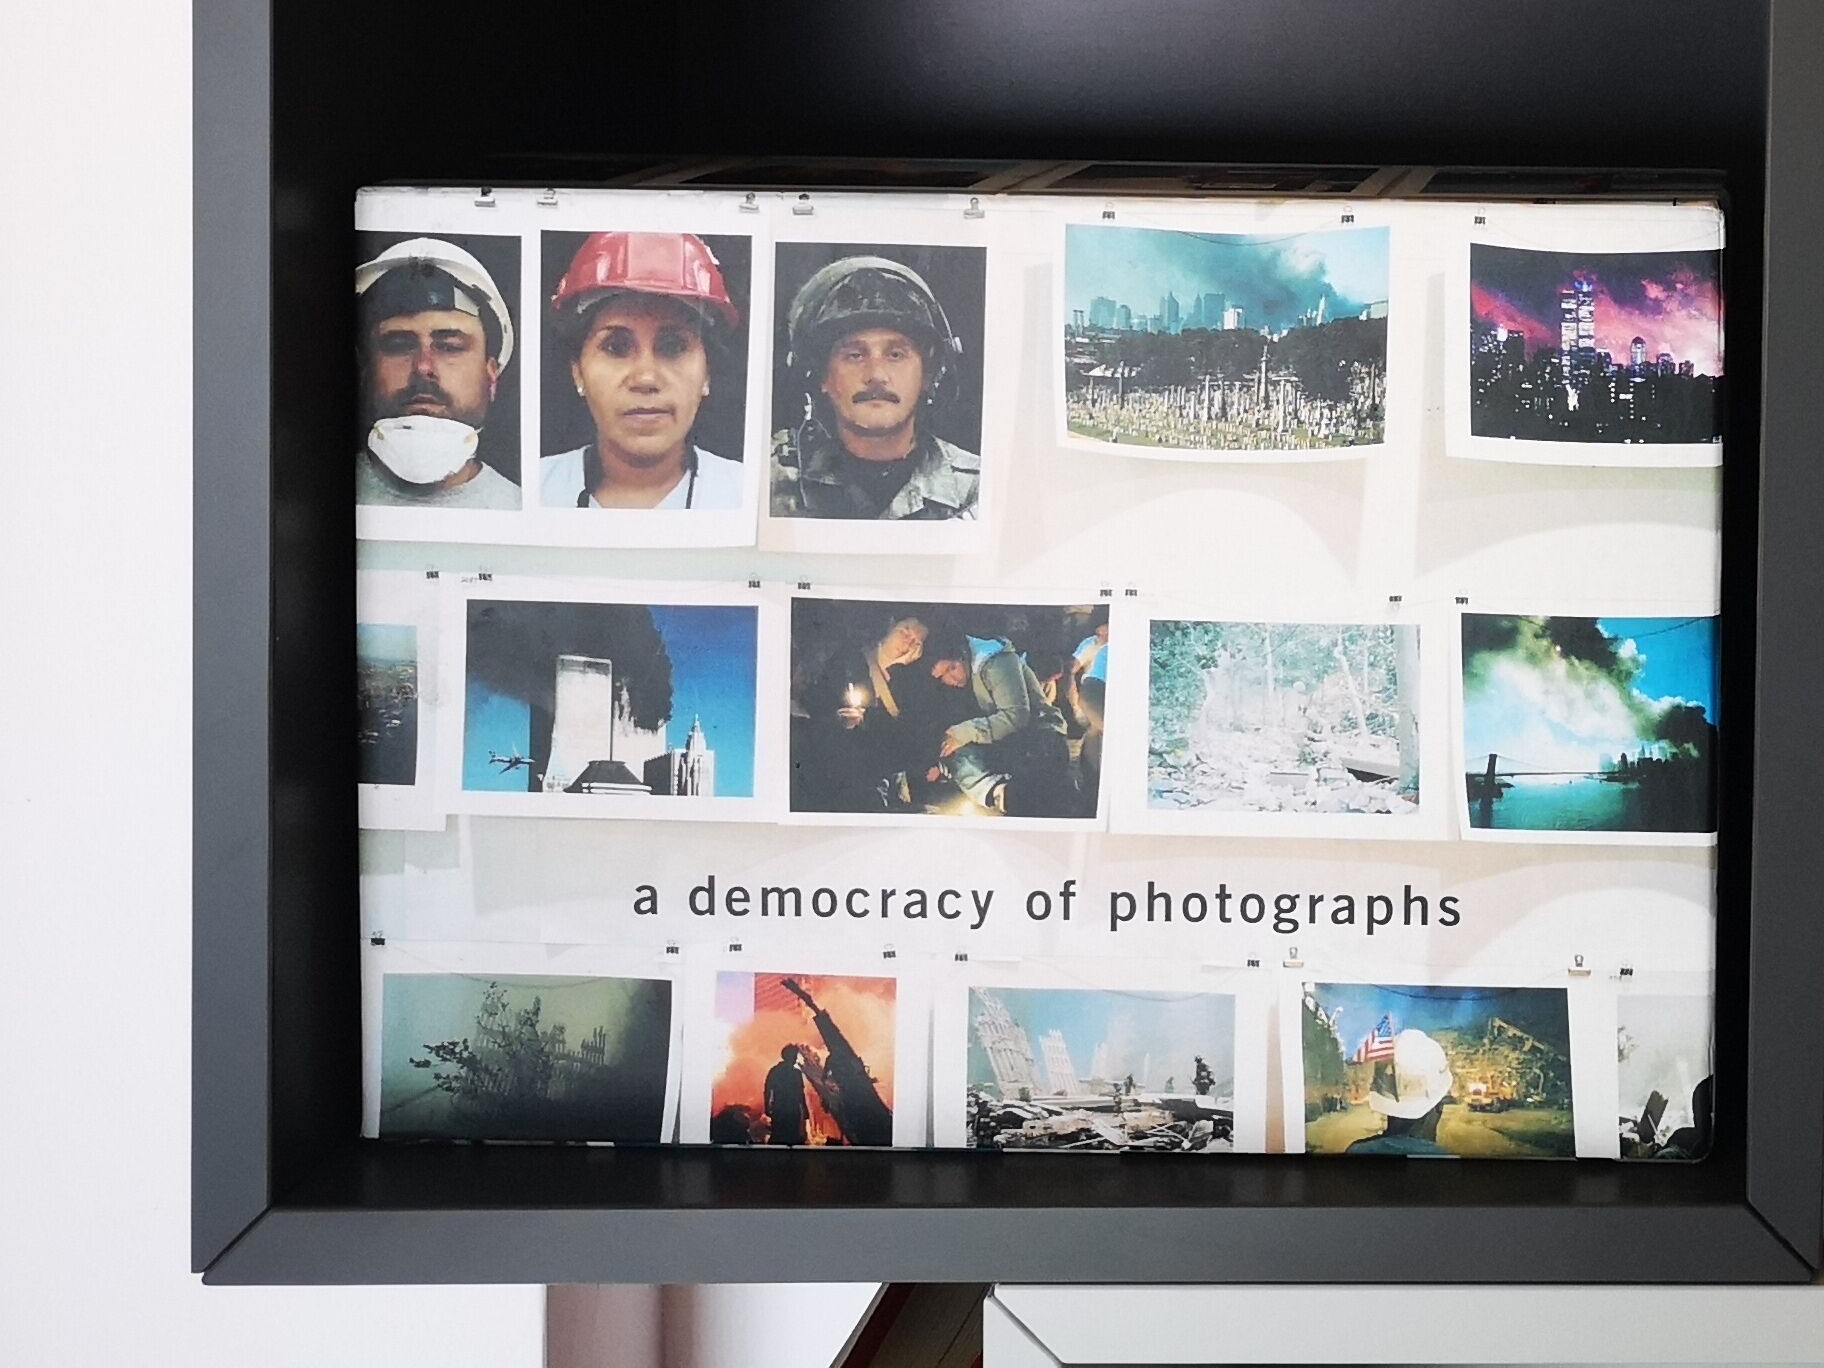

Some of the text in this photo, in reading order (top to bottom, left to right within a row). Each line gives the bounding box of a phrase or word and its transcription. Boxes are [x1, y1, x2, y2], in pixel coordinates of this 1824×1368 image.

[633, 874, 1463, 936] a democracy of photographs
